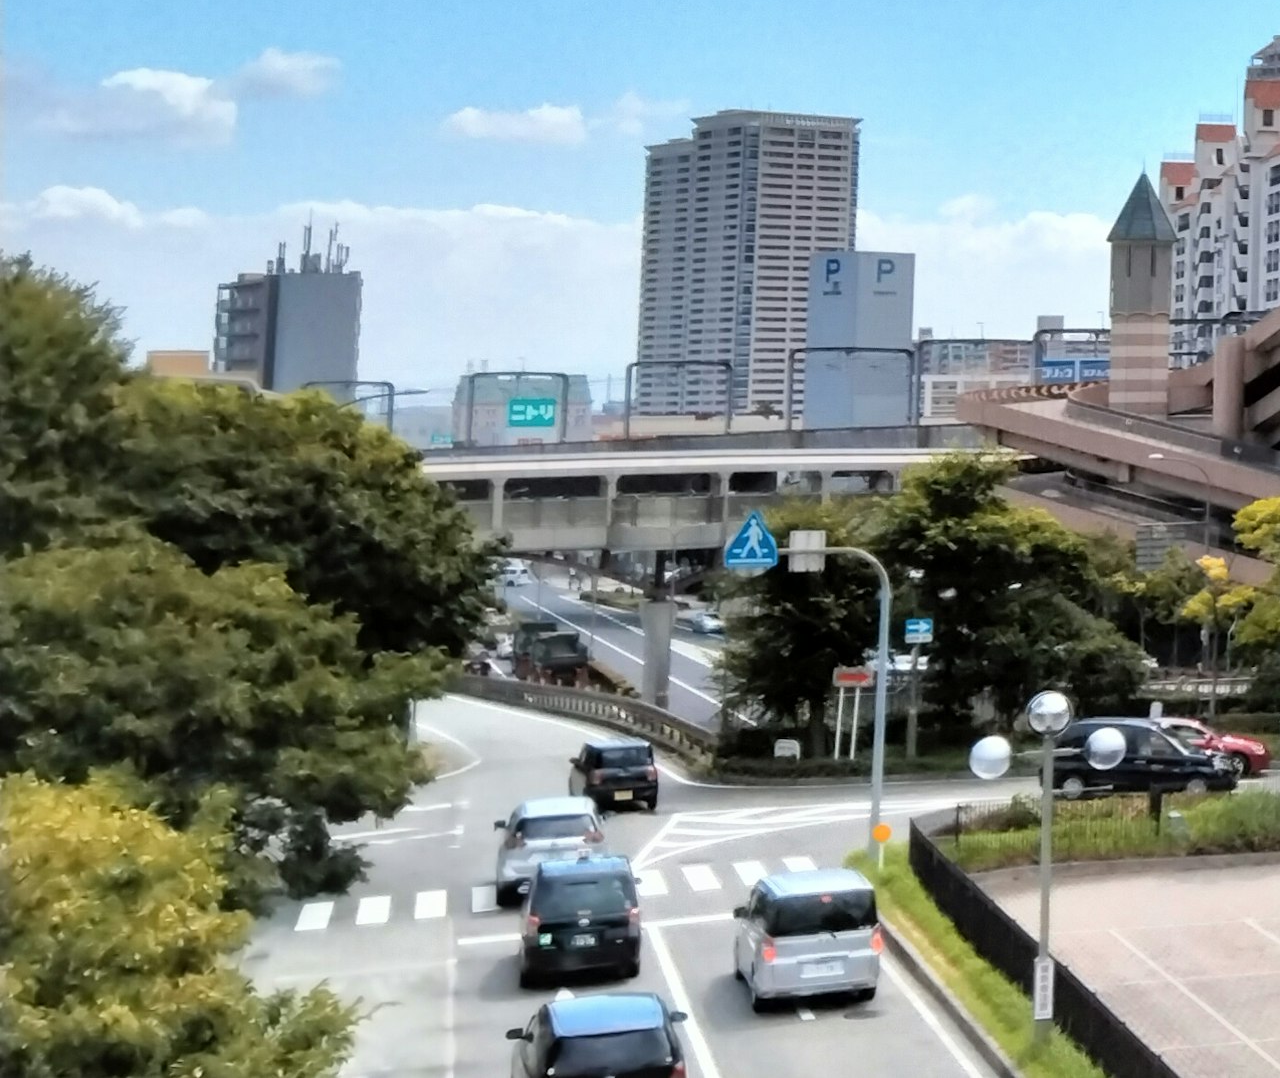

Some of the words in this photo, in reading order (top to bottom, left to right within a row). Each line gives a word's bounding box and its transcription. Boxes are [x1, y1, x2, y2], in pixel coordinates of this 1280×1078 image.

[826, 258, 841, 283] P
[877, 258, 896, 283] P
[511, 404, 554, 420] ニトリ
